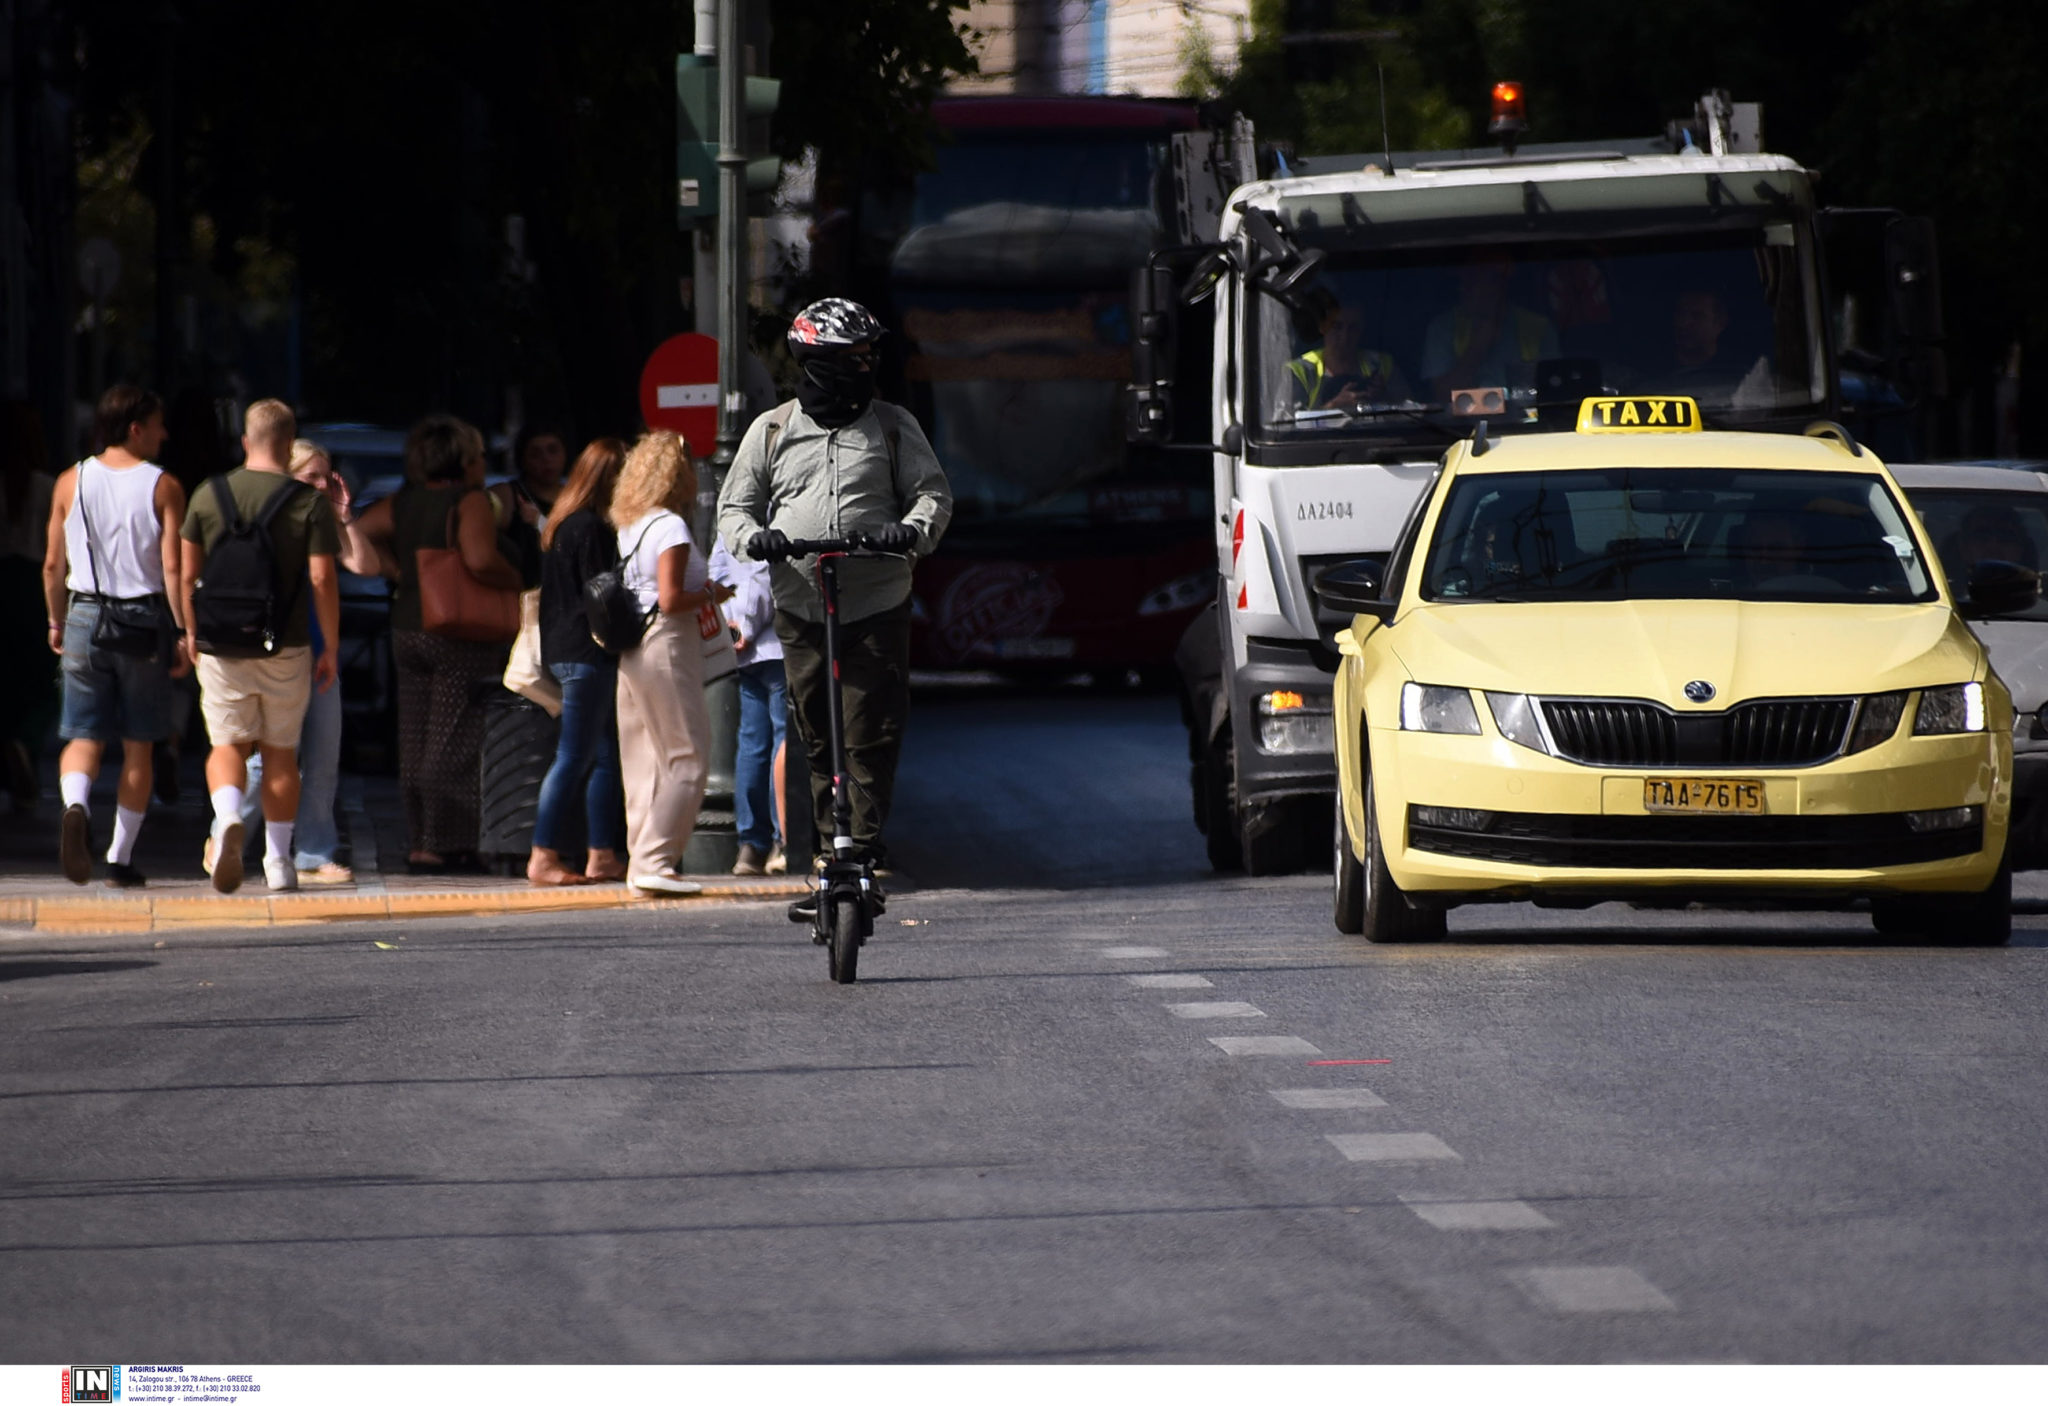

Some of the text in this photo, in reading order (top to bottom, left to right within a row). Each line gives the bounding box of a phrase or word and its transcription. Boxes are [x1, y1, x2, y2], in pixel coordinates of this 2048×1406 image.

[1598, 401, 1684, 424] TAXI
[1297, 501, 1353, 520] ΔΑ2404
[1649, 782, 1759, 808] TAA-7615
